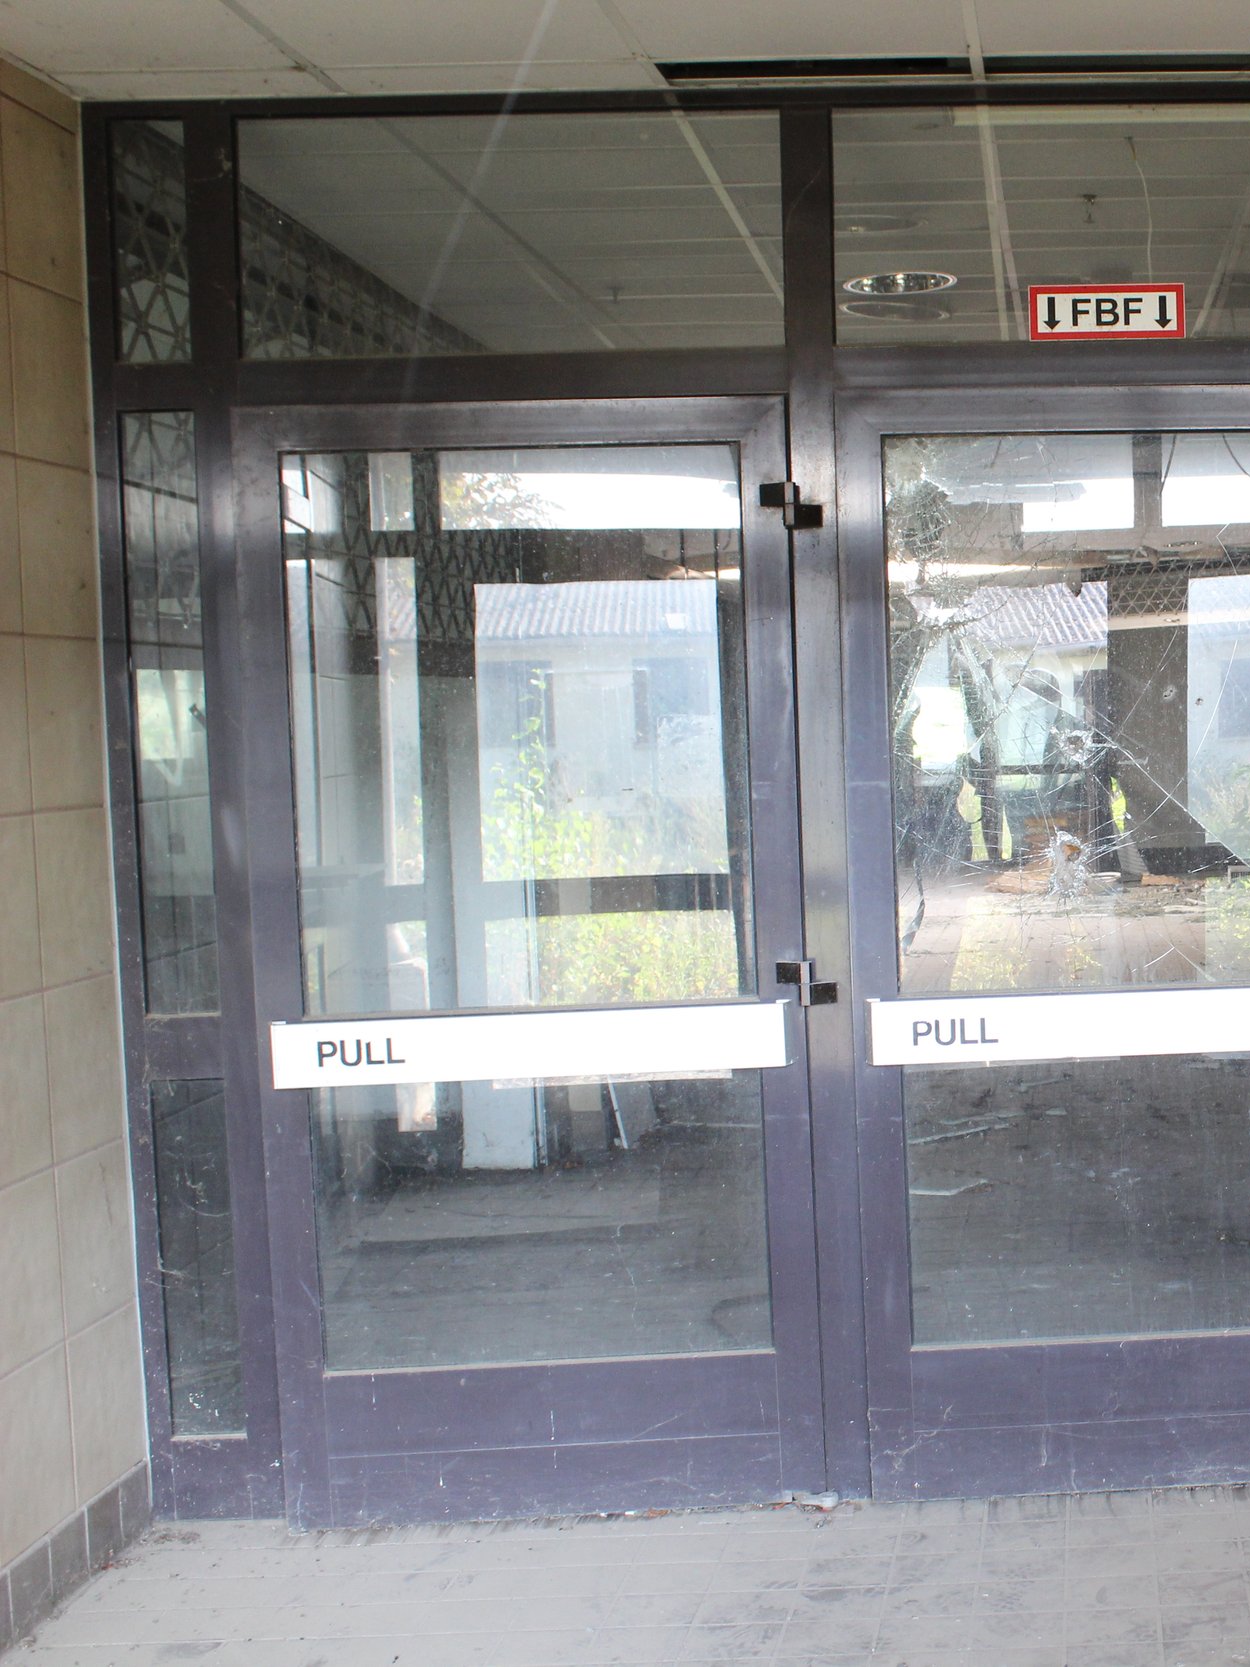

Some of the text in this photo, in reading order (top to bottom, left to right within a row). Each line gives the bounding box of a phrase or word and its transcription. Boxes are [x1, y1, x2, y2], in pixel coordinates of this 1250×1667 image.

[1071, 297, 1143, 327] FBF
[912, 1017, 999, 1046] PULL
[317, 1038, 405, 1067] PULL
